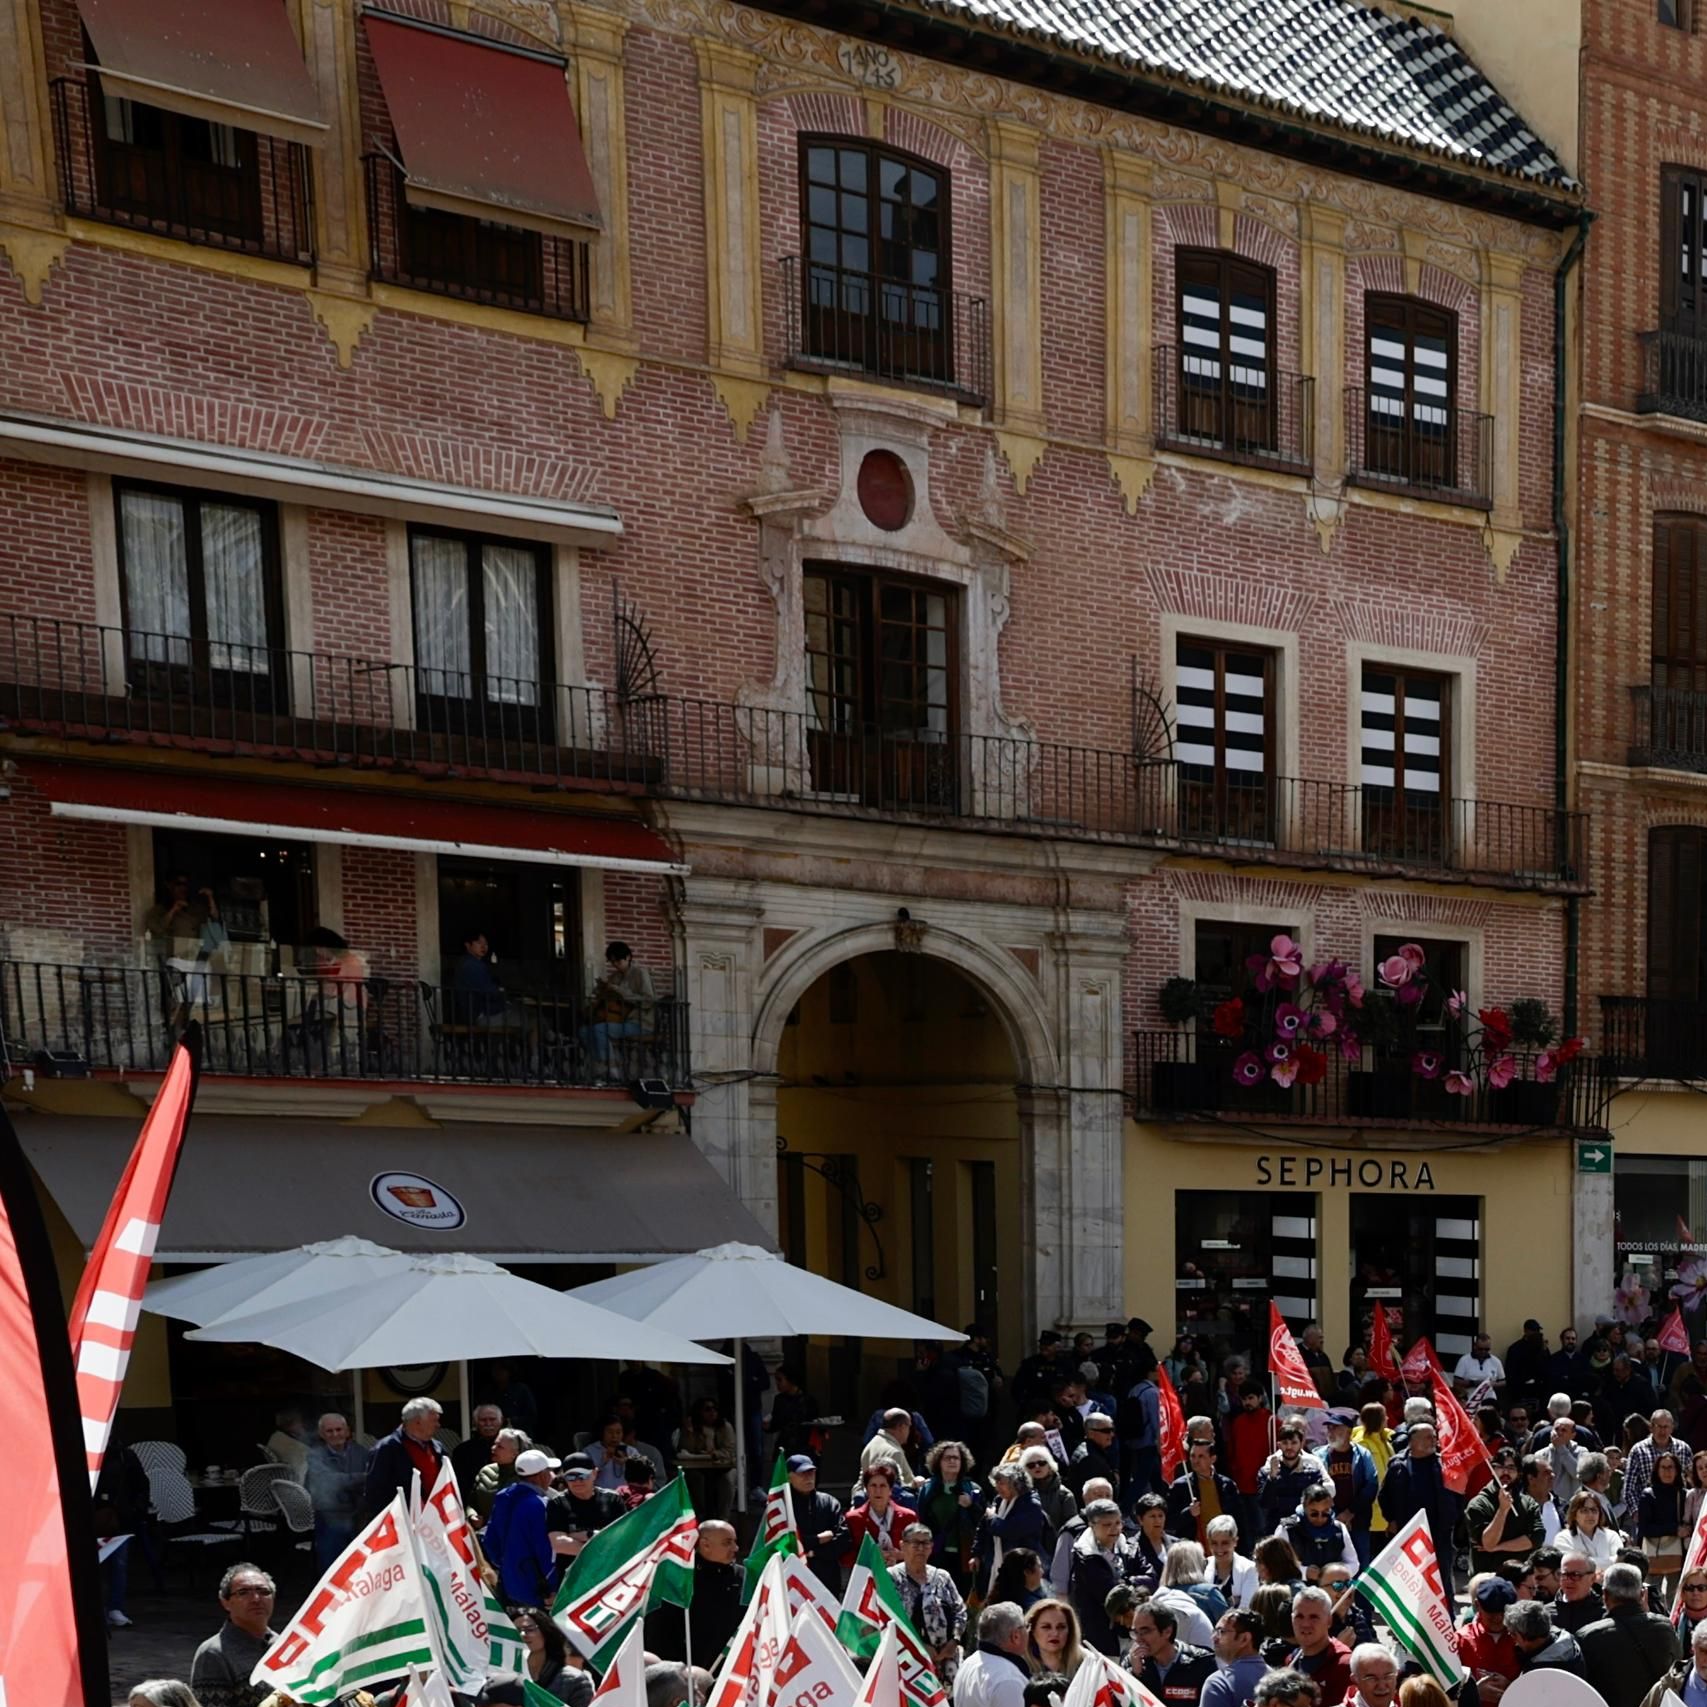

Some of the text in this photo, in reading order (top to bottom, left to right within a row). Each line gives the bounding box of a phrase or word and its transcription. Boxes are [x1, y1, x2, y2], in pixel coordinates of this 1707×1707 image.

[1256, 1156, 1434, 1190] SEPHORA
[1617, 1242, 1643, 1251] TODOS
[1645, 1242, 1658, 1251] LOS
[1680, 1243, 1707, 1251] MADRE
